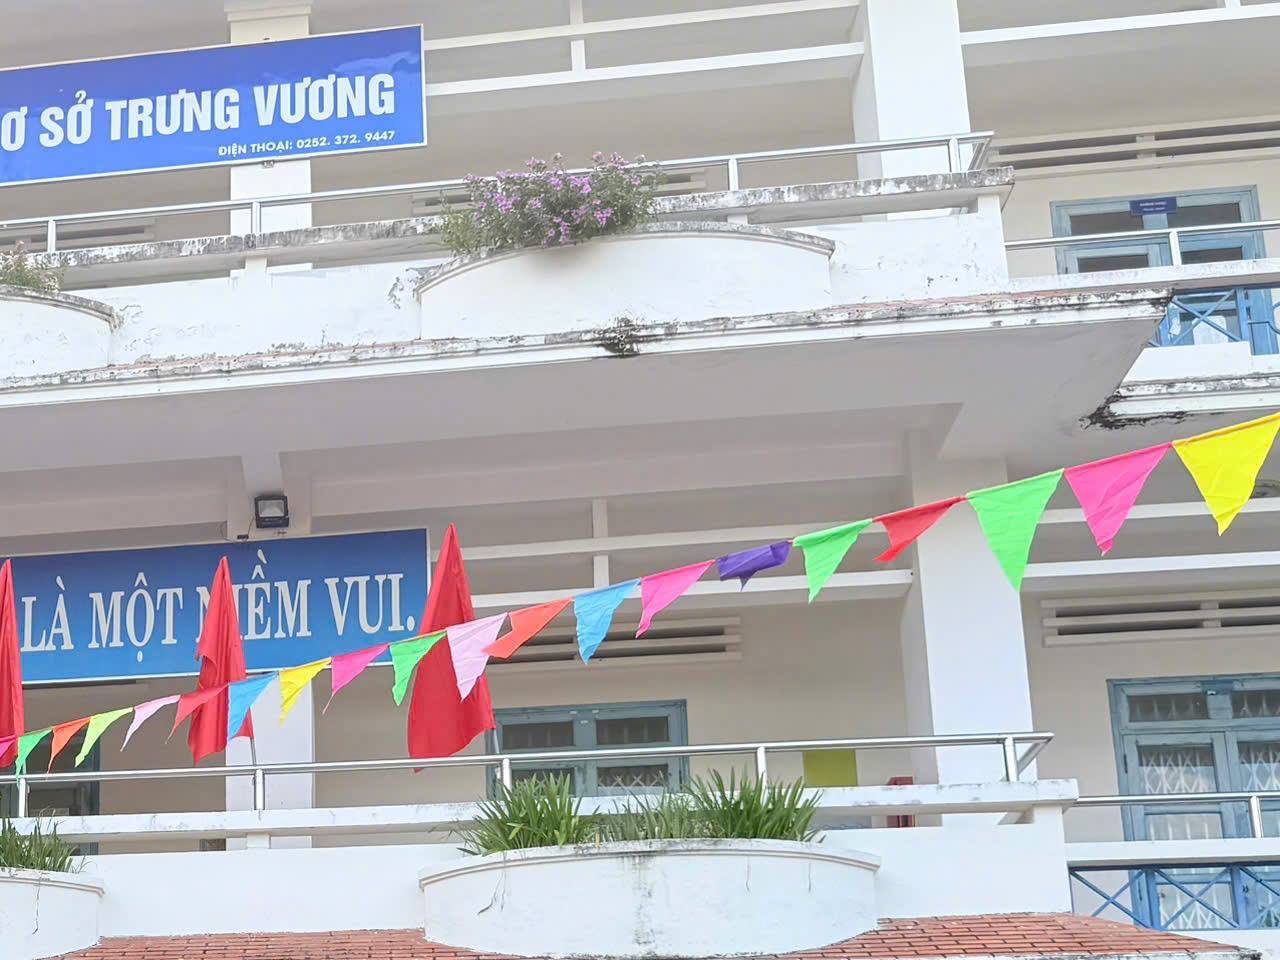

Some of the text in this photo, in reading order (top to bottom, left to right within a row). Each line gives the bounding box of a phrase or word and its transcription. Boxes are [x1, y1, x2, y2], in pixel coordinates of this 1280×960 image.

[39, 90, 94, 148] SỞ
[105, 88, 240, 141] TRƯNG
[253, 73, 395, 126] VƯƠNG
[218, 130, 395, 157] ĐIỆN THOẠI: 0252. 372. 9447
[21, 575, 74, 653] LÀ
[88, 572, 183, 663] MỘT
[325, 573, 415, 636] VUI.
